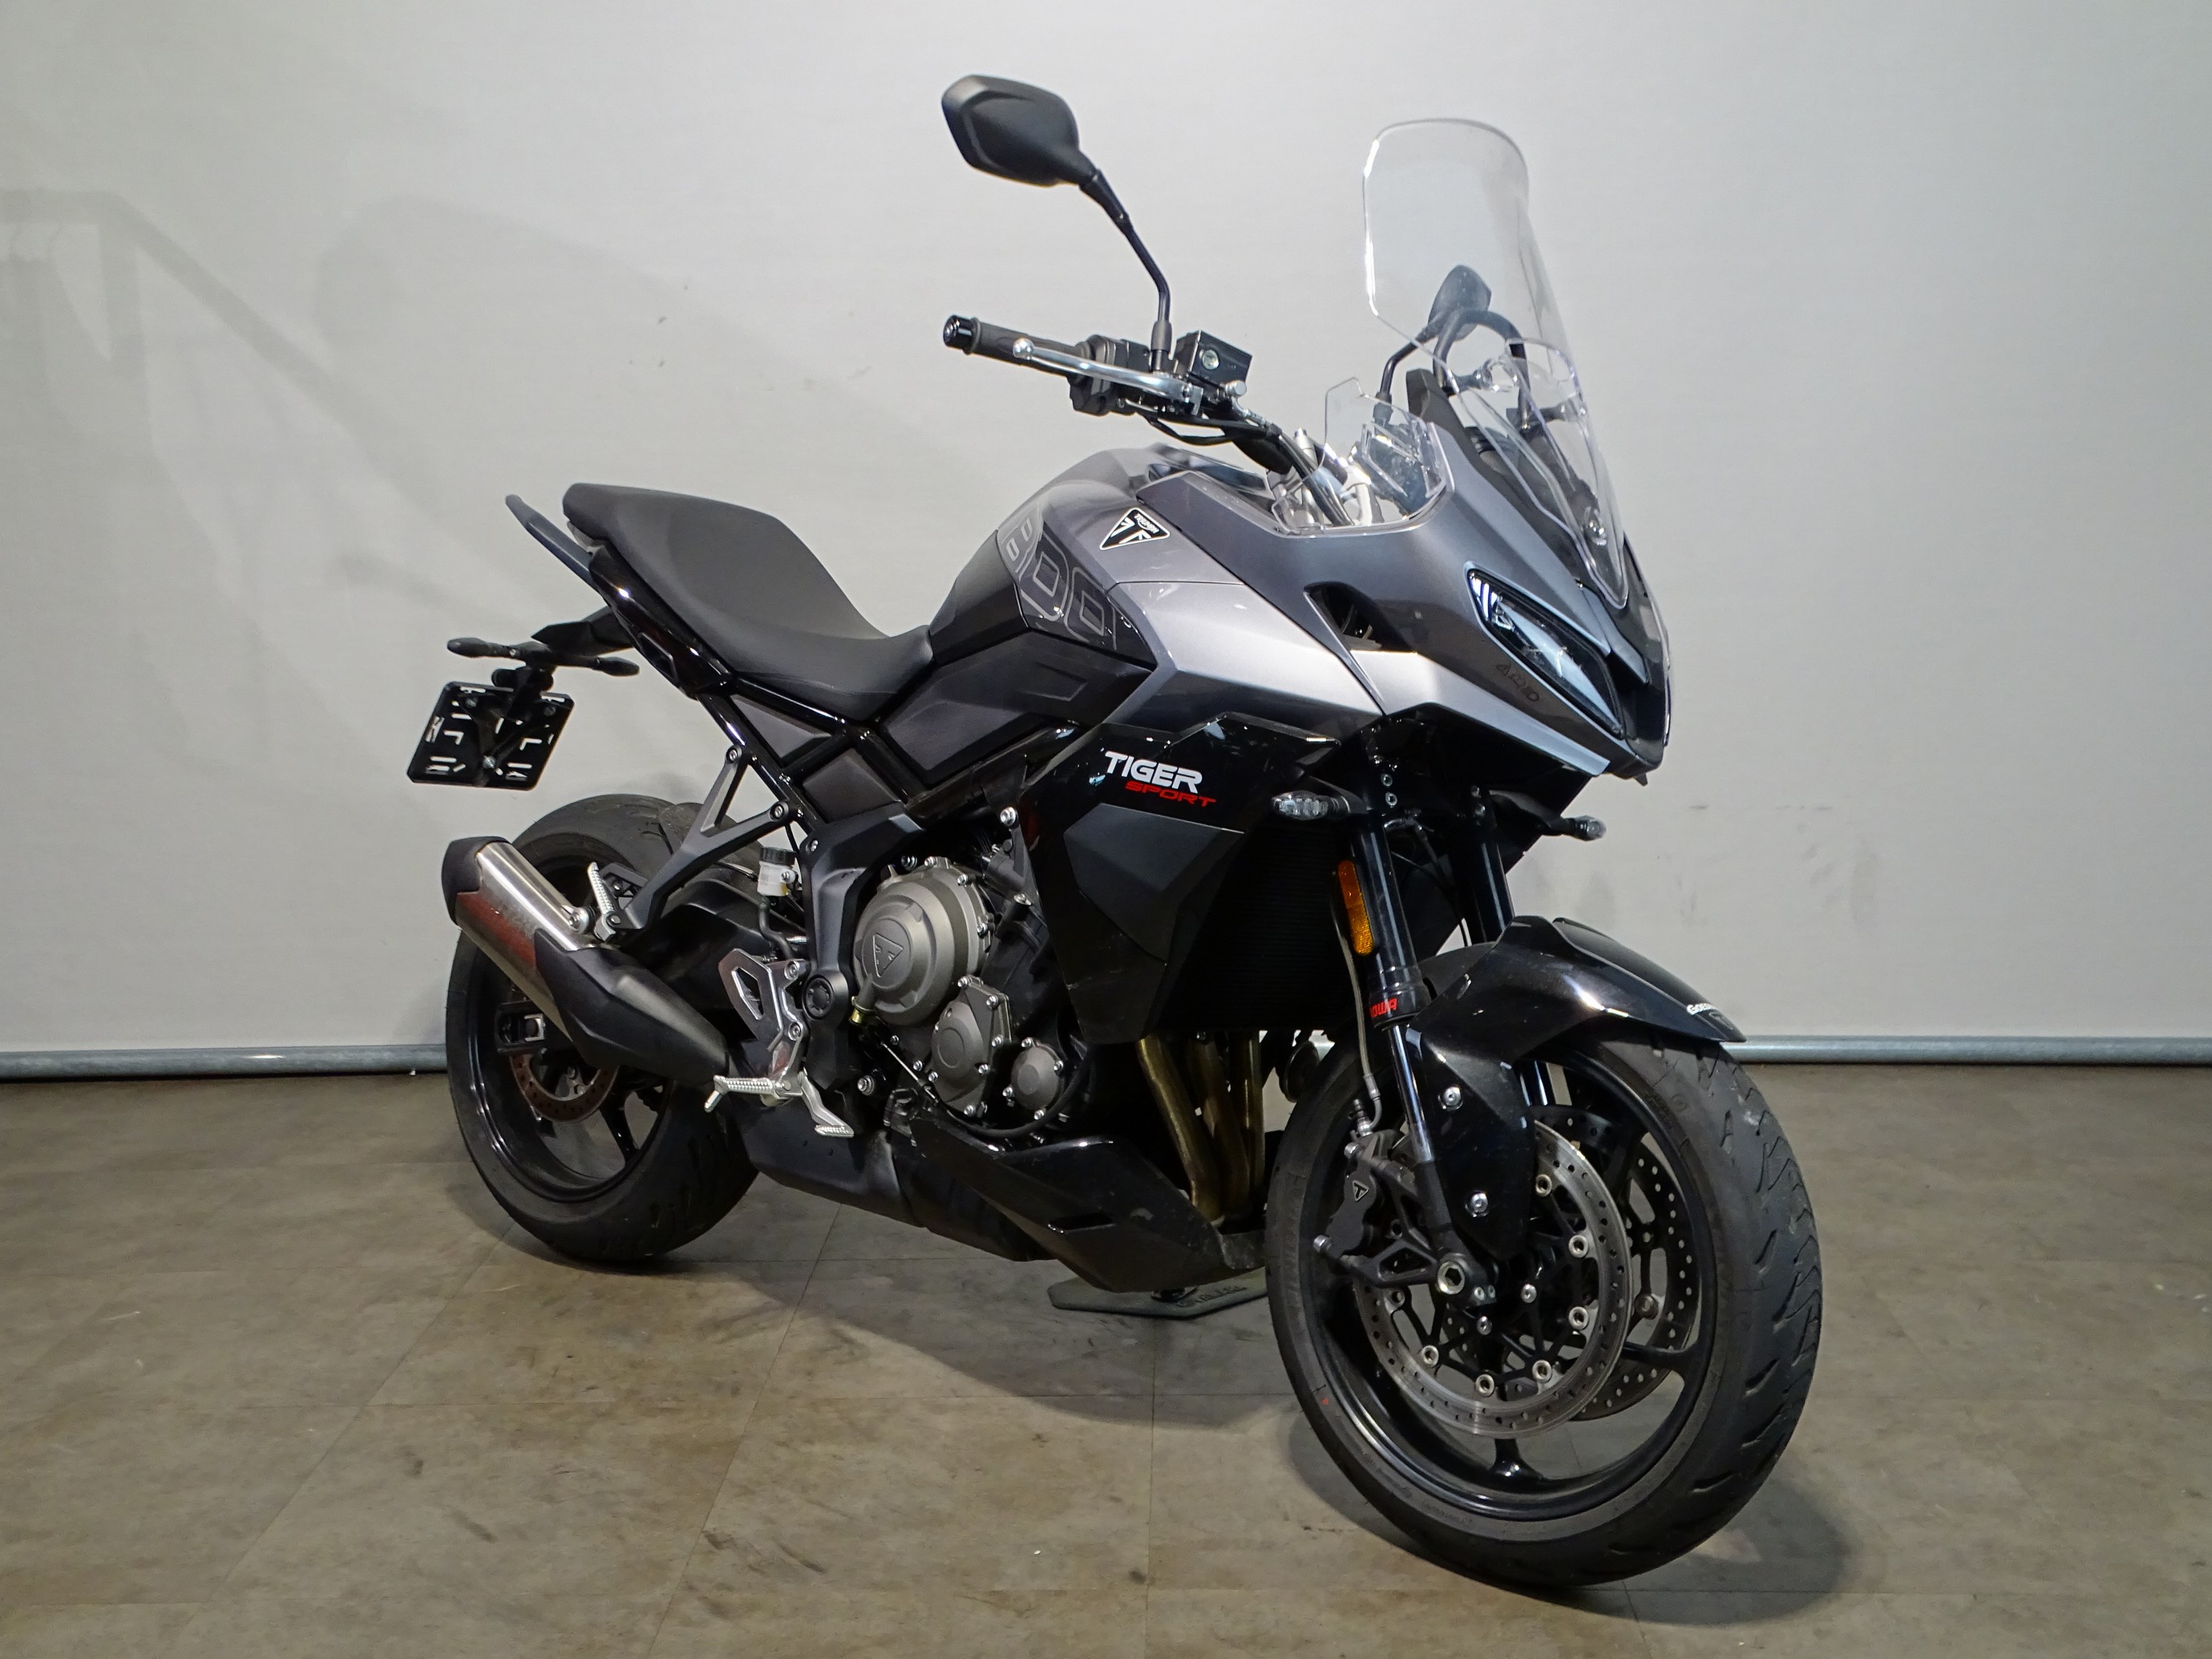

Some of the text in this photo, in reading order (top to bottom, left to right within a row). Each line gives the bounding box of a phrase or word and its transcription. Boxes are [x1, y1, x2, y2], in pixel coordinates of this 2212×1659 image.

[1134, 512, 1159, 534] TRIUMPH
[1105, 751, 1203, 794] TIGER
[1125, 780, 1216, 807] SPORT
